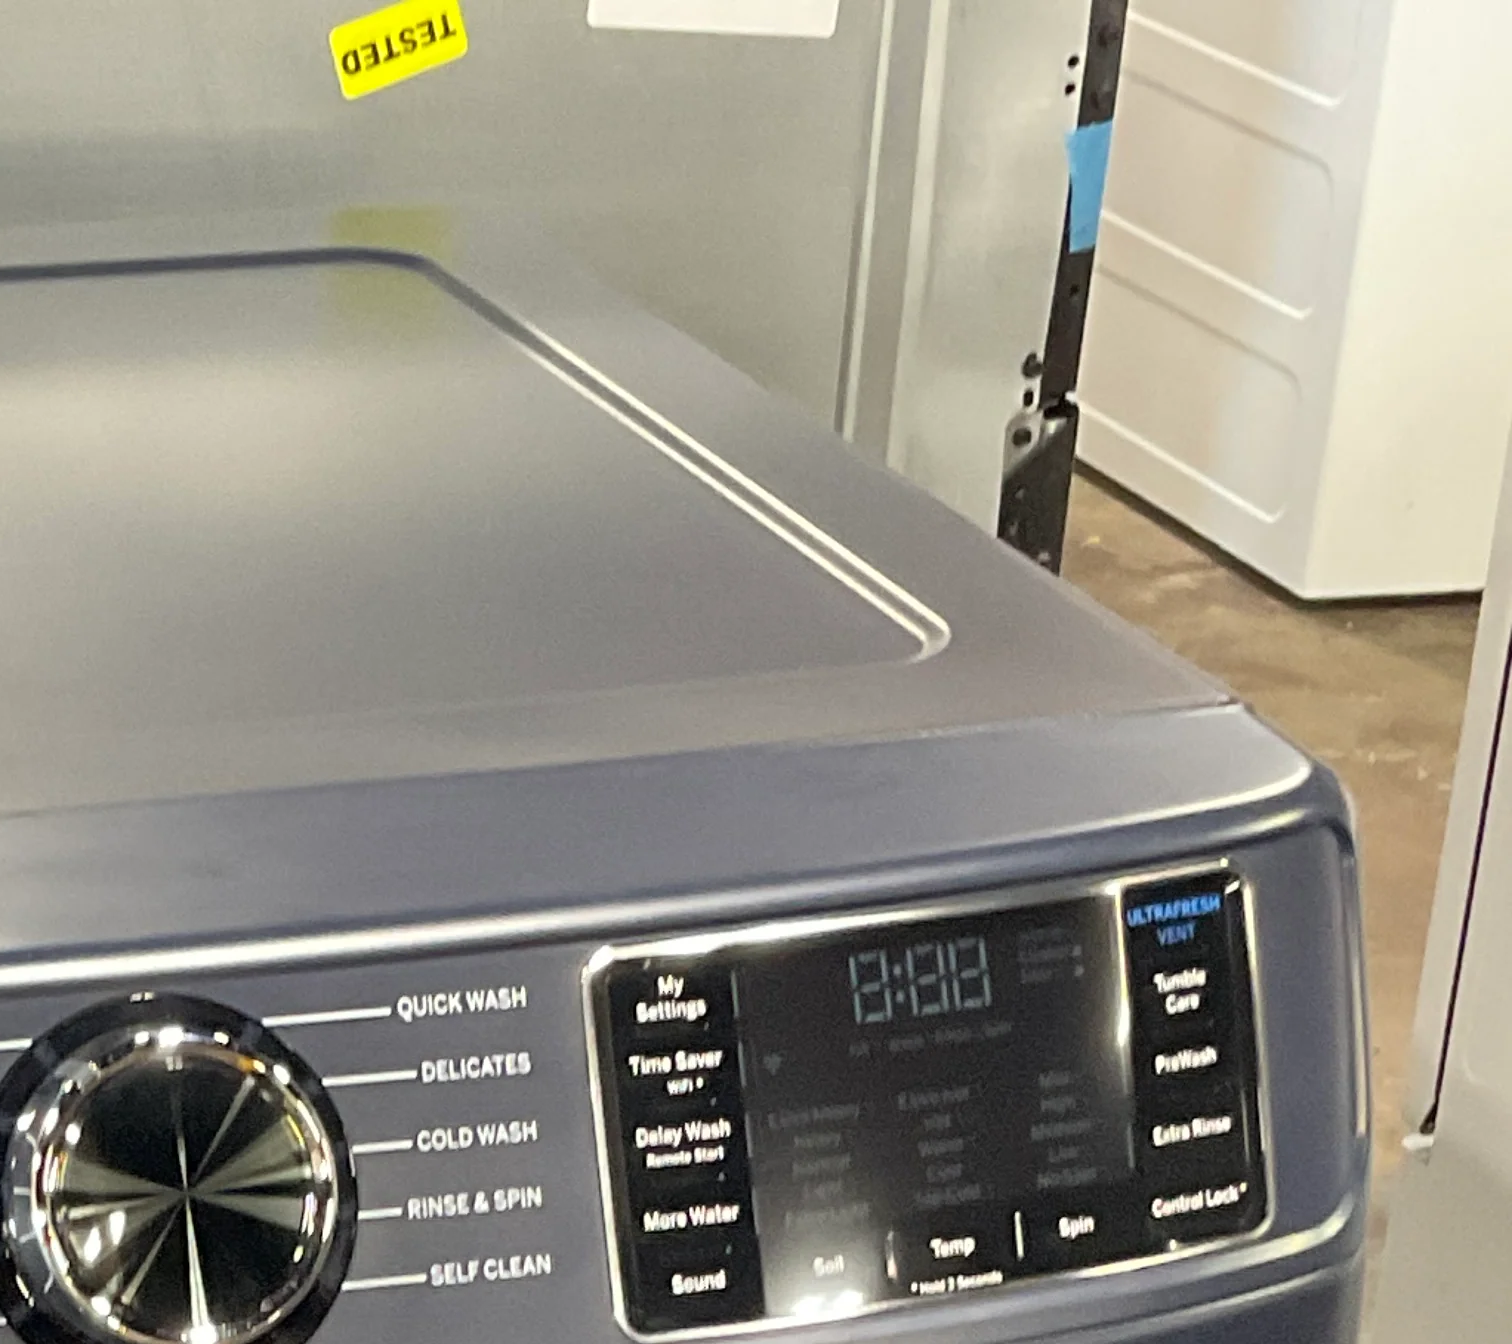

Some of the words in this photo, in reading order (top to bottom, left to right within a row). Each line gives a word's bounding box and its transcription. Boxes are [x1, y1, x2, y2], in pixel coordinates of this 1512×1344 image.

[341, 11, 457, 76] TESTED
[1126, 893, 1222, 927] ULTRAFRESH
[1156, 921, 1196, 946] VENT
[657, 974, 685, 998] My
[396, 990, 463, 1023] QUICK
[465, 986, 528, 1013] WASH
[635, 998, 708, 1023] Settings
[1164, 993, 1201, 1015] Care
[420, 1052, 532, 1084] DELICATES
[627, 1054, 673, 1077] Time
[674, 1050, 724, 1072] Saver
[416, 1125, 474, 1152] COLD
[476, 1120, 539, 1147] WASH
[635, 1125, 683, 1149] Delay
[684, 1117, 732, 1142] Wash
[1152, 1124, 1191, 1147] Extra
[1191, 1116, 1232, 1139] Rinse
[407, 1192, 469, 1220] RINSE
[473, 1191, 490, 1214] &
[493, 1185, 543, 1211] SPIN
[1151, 1190, 1204, 1218] Control
[642, 1210, 688, 1233] More
[688, 1203, 740, 1227] Water
[1058, 1215, 1096, 1240] Spin
[929, 1237, 976, 1259] Temp
[429, 1260, 480, 1287] SELF
[482, 1254, 553, 1281] CLEAN
[812, 1254, 845, 1278] Soil
[671, 1269, 727, 1296] Sound
